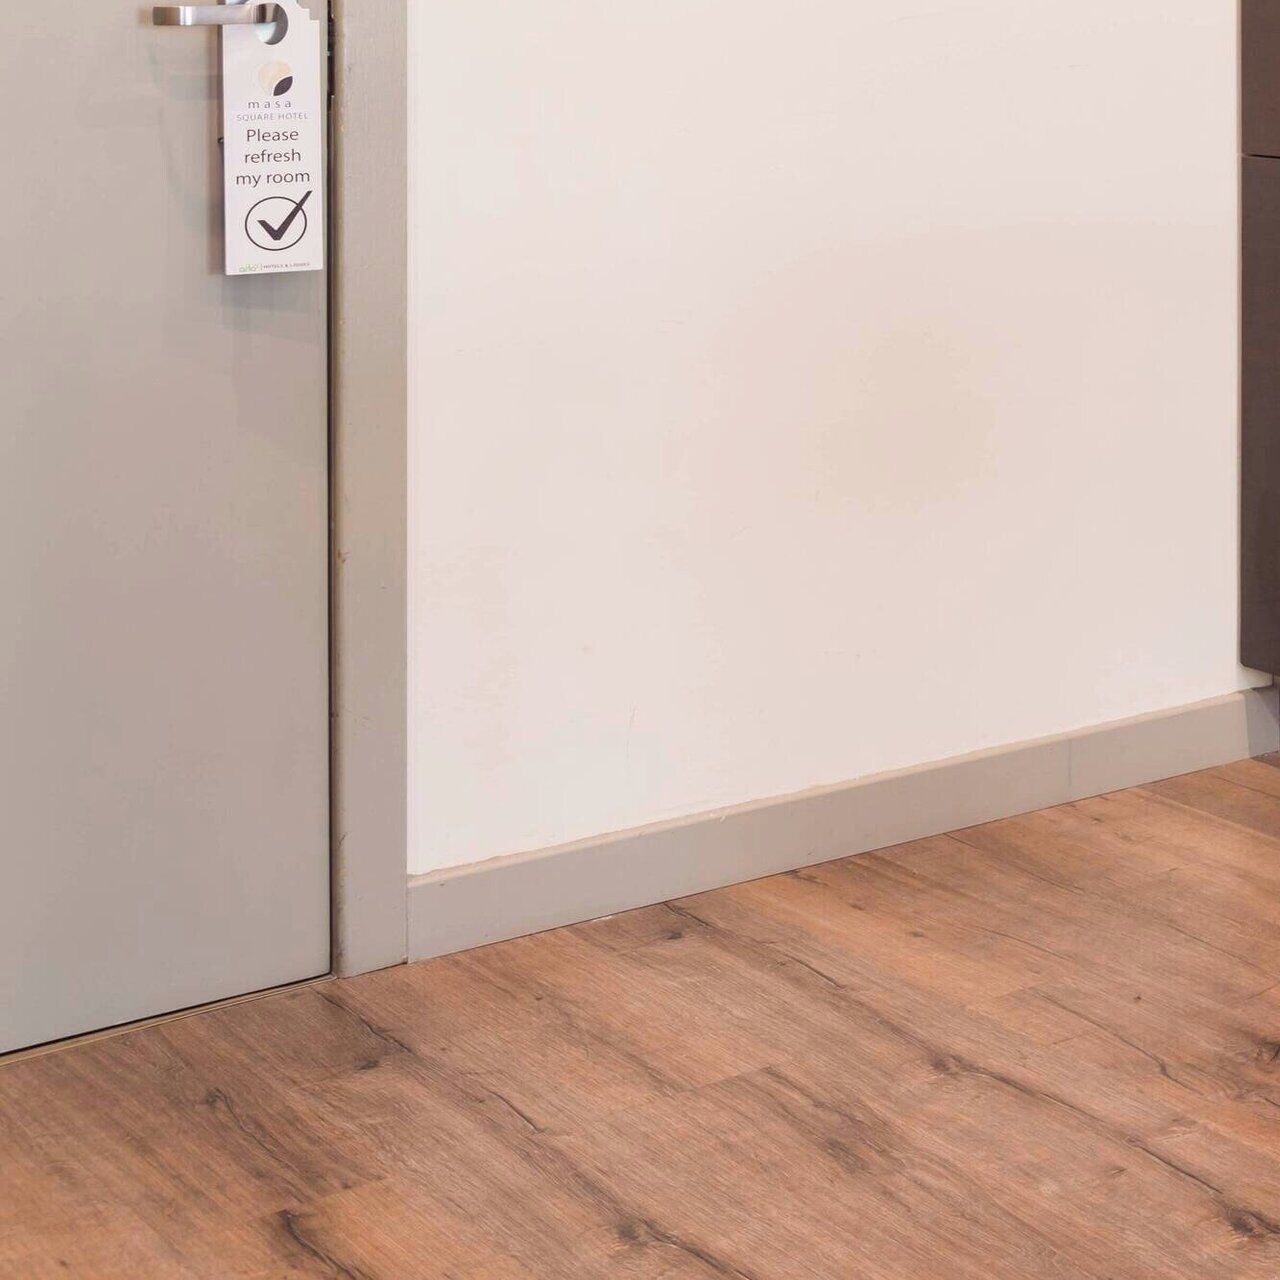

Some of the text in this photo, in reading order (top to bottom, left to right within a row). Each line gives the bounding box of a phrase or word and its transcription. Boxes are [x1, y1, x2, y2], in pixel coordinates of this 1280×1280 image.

[248, 100, 291, 109] masa
[236, 112, 309, 122] SQUARE HOTEL
[246, 129, 299, 142] Please
[245, 149, 301, 164] refresh
[236, 172, 310, 188] my room
